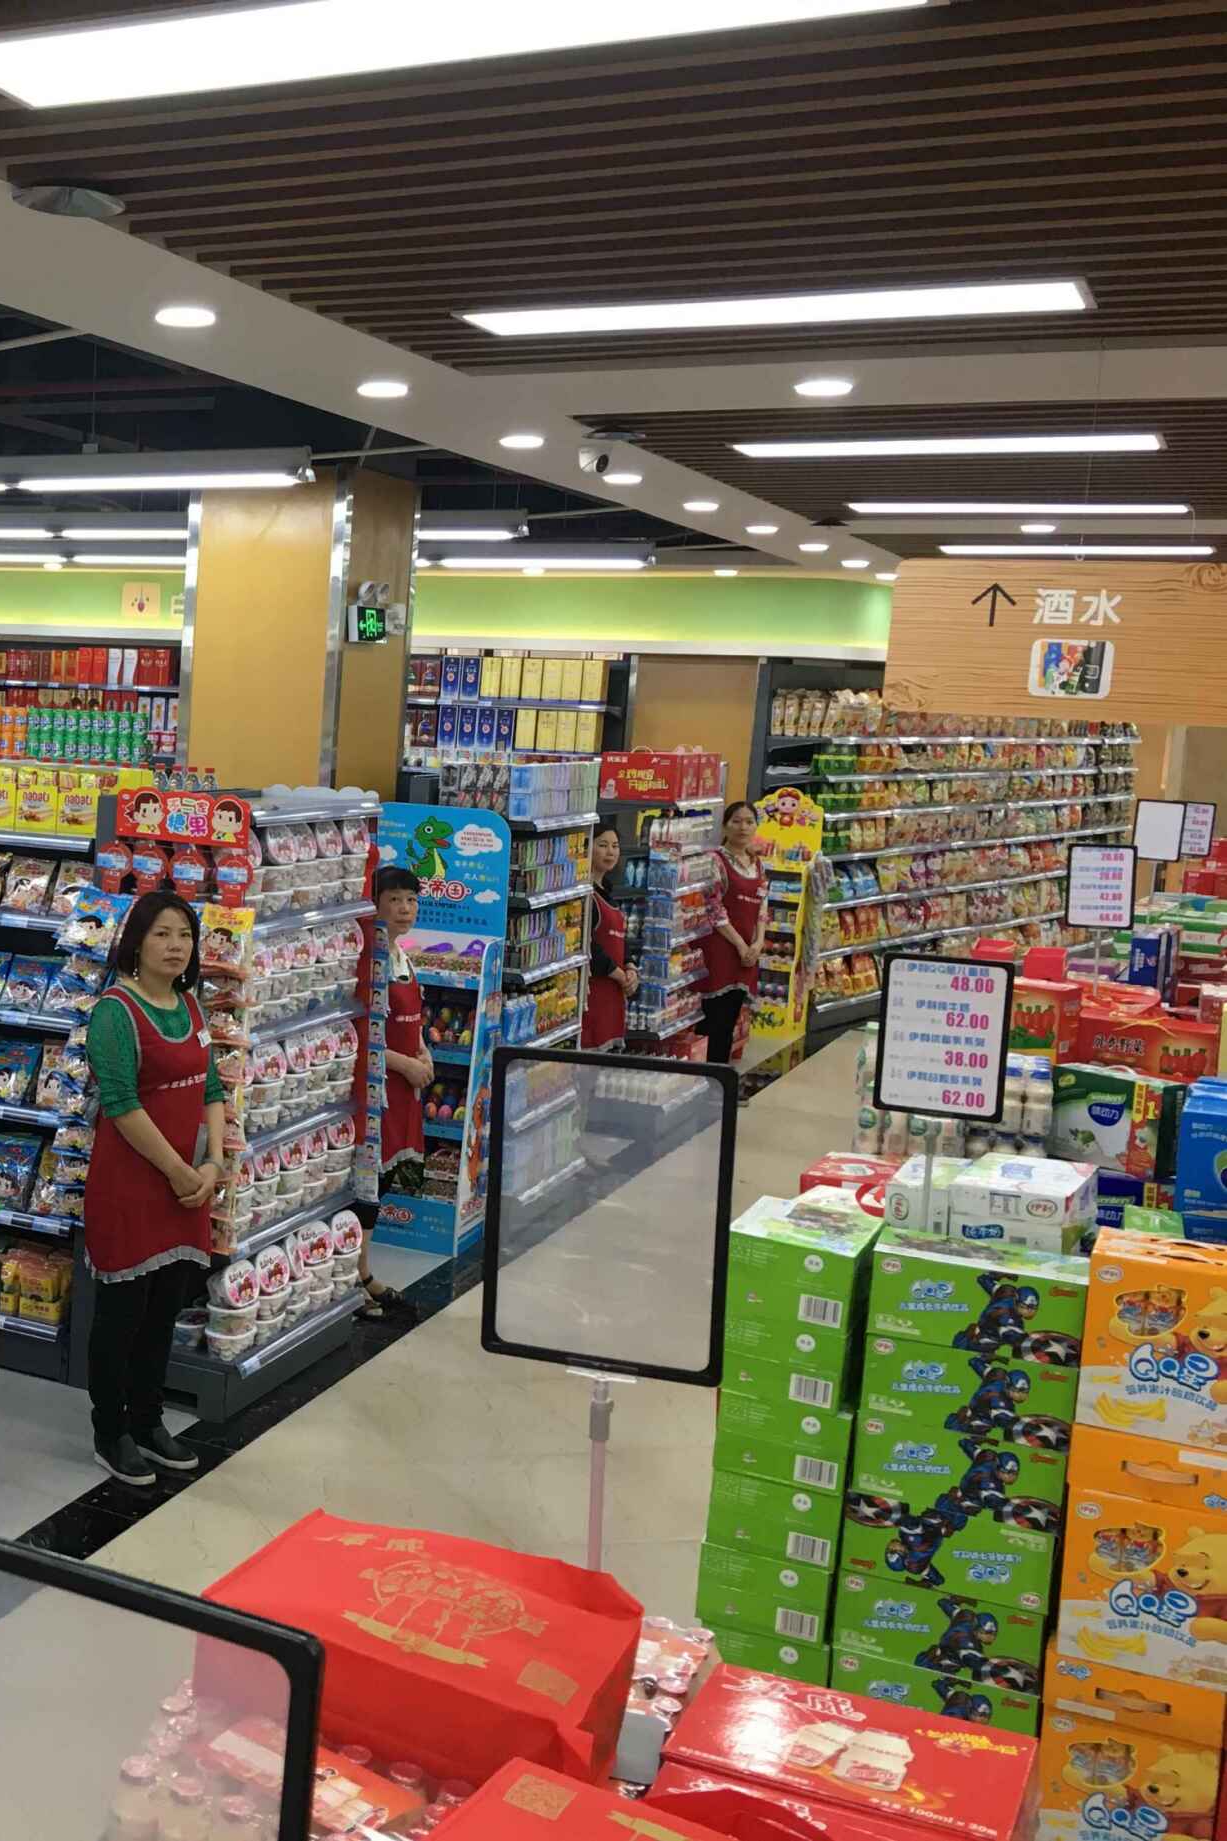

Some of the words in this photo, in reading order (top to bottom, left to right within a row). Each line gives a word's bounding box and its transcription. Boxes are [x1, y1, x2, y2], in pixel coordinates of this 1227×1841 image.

[1032, 588, 1122, 626] 酒水
[22, 791, 49, 802] nabati
[65, 794, 92, 806] nabati
[166, 797, 210, 815] 不二家
[167, 812, 208, 837] 糖果
[950, 976, 994, 993] 48.00
[946, 1012, 989, 1029] 62.00
[944, 1051, 988, 1068] 38.00
[942, 1090, 985, 1108] 62.00
[1130, 1343, 1219, 1391] QQ星
[1109, 1578, 1197, 1628] QQ星
